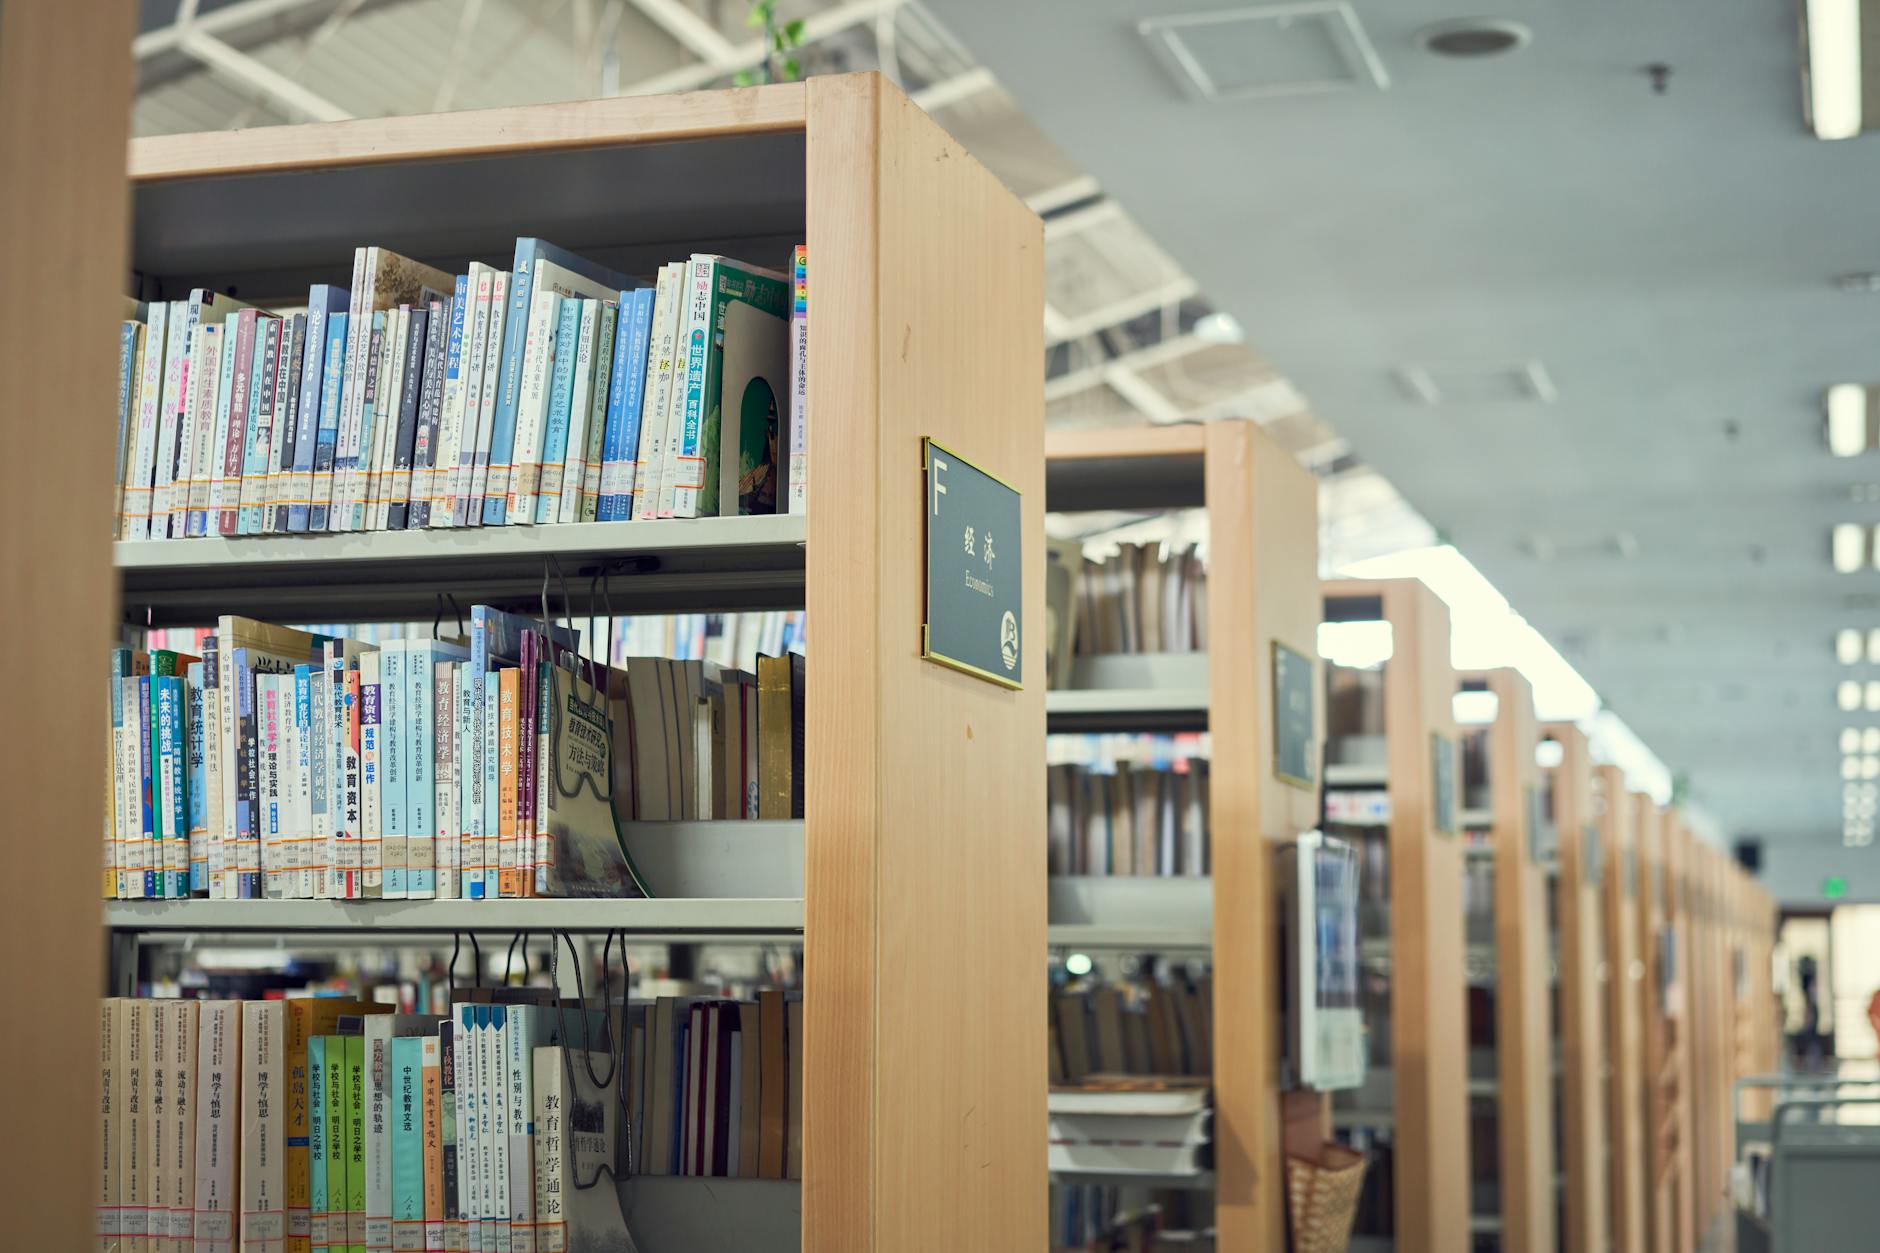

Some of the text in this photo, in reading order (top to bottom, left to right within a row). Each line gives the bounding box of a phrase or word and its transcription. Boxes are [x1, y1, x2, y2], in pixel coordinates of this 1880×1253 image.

[448, 281, 467, 370] 审美艺术教程
[693, 281, 708, 321] 励志中国
[471, 309, 486, 373] 教育美学十讲
[487, 309, 502, 373] 教育美学十讲
[687, 344, 705, 395] 世界遗产
[685, 399, 698, 441] 百科全书
[934, 457, 947, 516] F
[964, 525, 995, 571] 经济
[965, 569, 994, 598] Economics
[160, 687, 173, 753] 未来的挑战
[191, 686, 204, 769] 教育统计学
[333, 683, 343, 729] 现代教育技术
[364, 685, 376, 725] 教育资本
[463, 689, 471, 734] 教育与新人
[500, 688, 514, 777] 教育技术学
[248, 737, 257, 801] 学校社会工作
[346, 756, 357, 824] 教育资本
[210, 1072, 222, 1119] 博学与慎思
[257, 1072, 269, 1118] 博学与慎思
[312, 1064, 322, 1161] 学校与社会·明日之学校
[330, 1063, 340, 1161] 学校与社会·明日之学校
[352, 1065, 362, 1162] 学校与社会·明日之学校
[403, 1065, 413, 1133] 中世纪教育文选
[426, 1075, 437, 1150] 中国教育思想史
[512, 1069, 523, 1134] 性别与教育
[544, 1095, 560, 1215] 教育哲学通论
